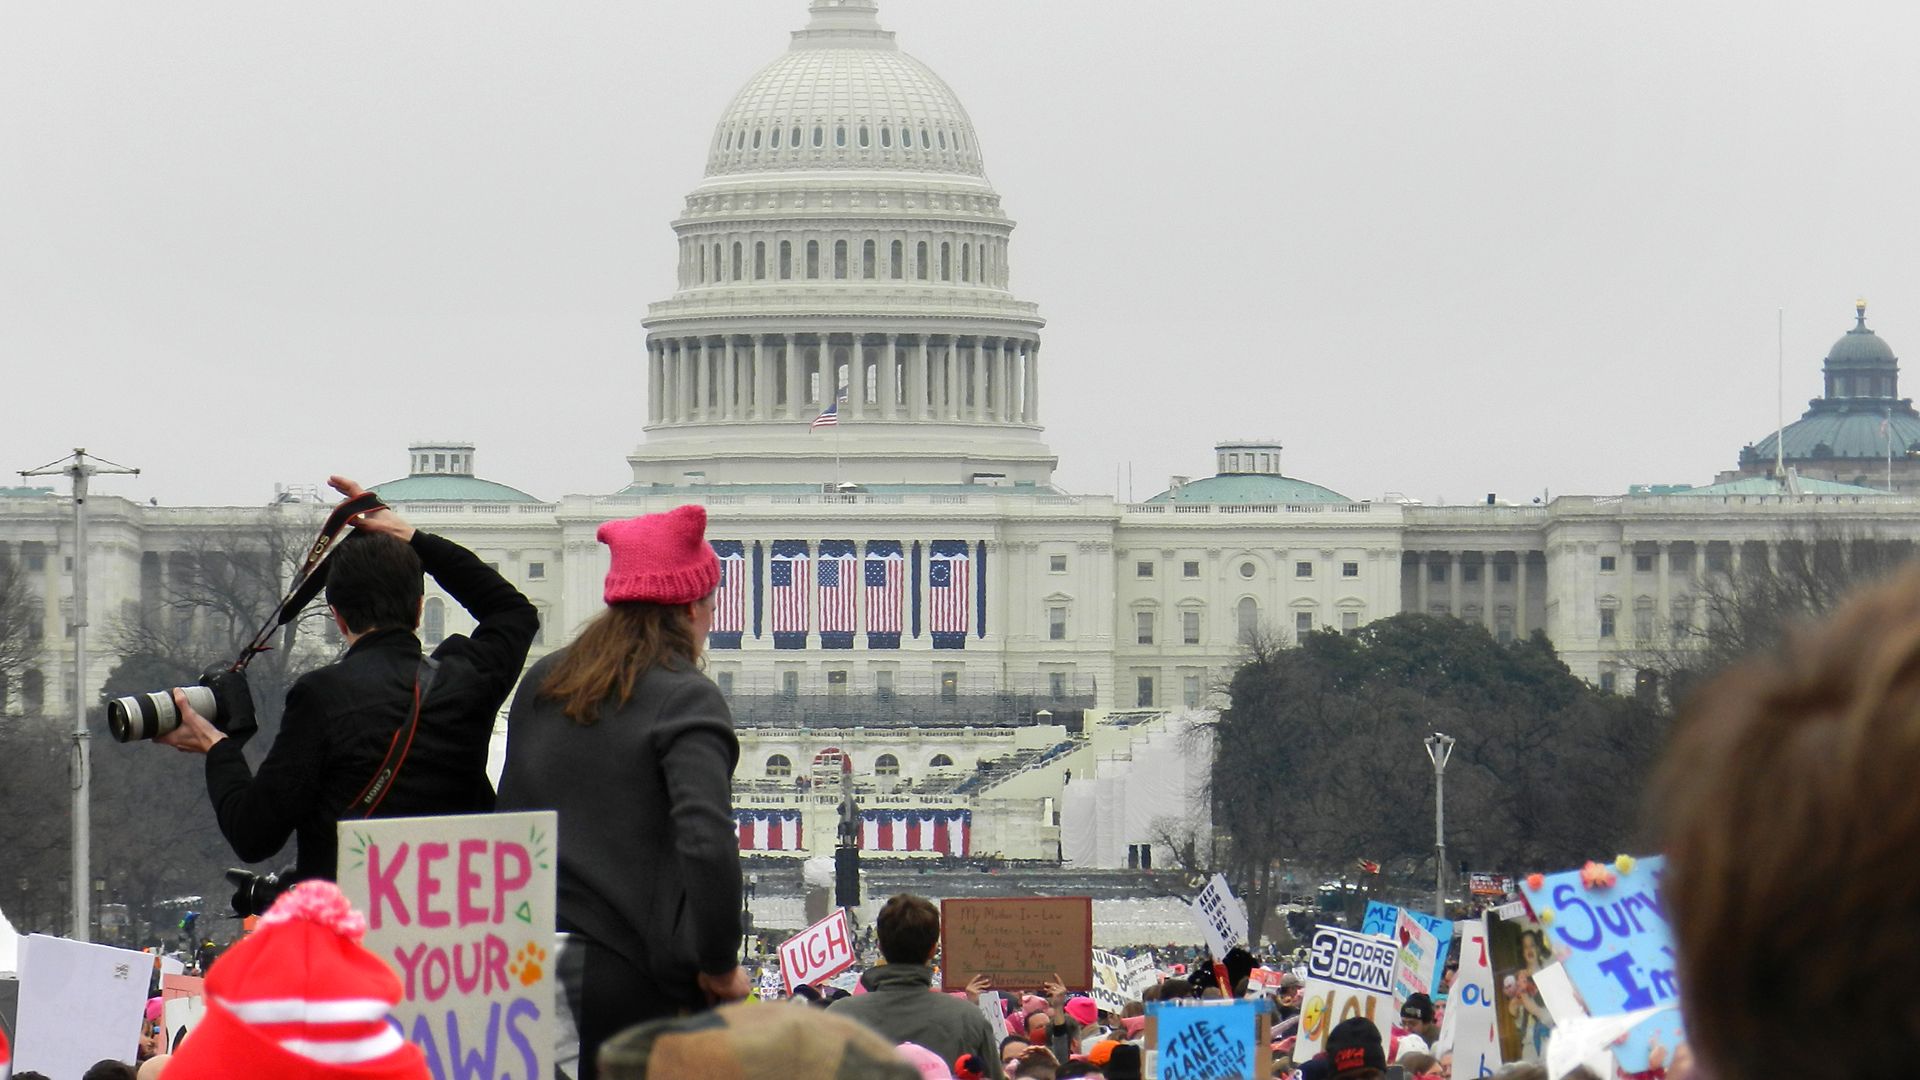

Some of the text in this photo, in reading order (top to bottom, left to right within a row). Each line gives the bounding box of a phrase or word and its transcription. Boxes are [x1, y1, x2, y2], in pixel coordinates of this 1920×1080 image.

[309, 534, 330, 563] EOS
[364, 768, 391, 804] Canon
[367, 838, 532, 930] KEEP
[1199, 884, 1215, 907] KEEP
[1203, 893, 1221, 915] YOUR
[1367, 906, 1398, 923] ME
[789, 918, 848, 979] UGH
[1220, 924, 1232, 940] MY
[394, 933, 510, 1002] YOUR
[1311, 934, 1337, 972] 3
[1338, 939, 1394, 967] DOORS
[1334, 958, 1390, 988] DOWN
[384, 998, 541, 1080] AWS
[1164, 1025, 1229, 1080] PLANET
[1165, 1020, 1211, 1058] THE
